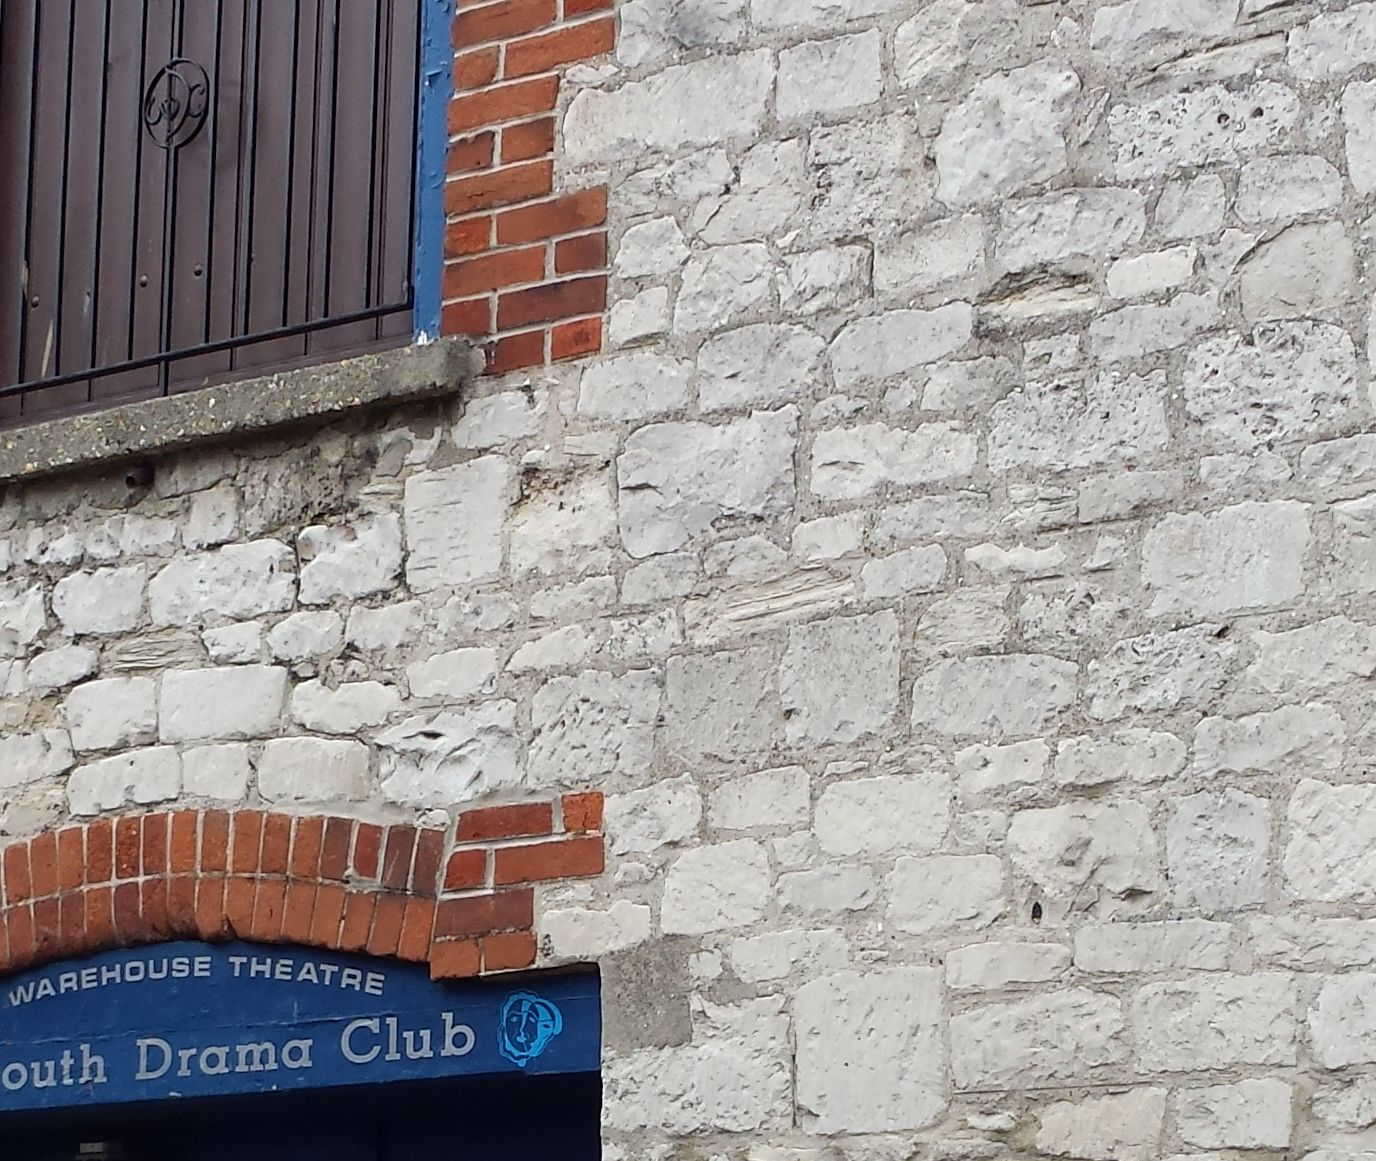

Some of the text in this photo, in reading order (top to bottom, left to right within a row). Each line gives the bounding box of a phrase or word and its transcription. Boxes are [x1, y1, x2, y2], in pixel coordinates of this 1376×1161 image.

[7, 955, 213, 1008] WAREHOUSE
[227, 955, 387, 997] THEATRE
[134, 1036, 314, 1081] Drama
[340, 1011, 476, 1065] Club
